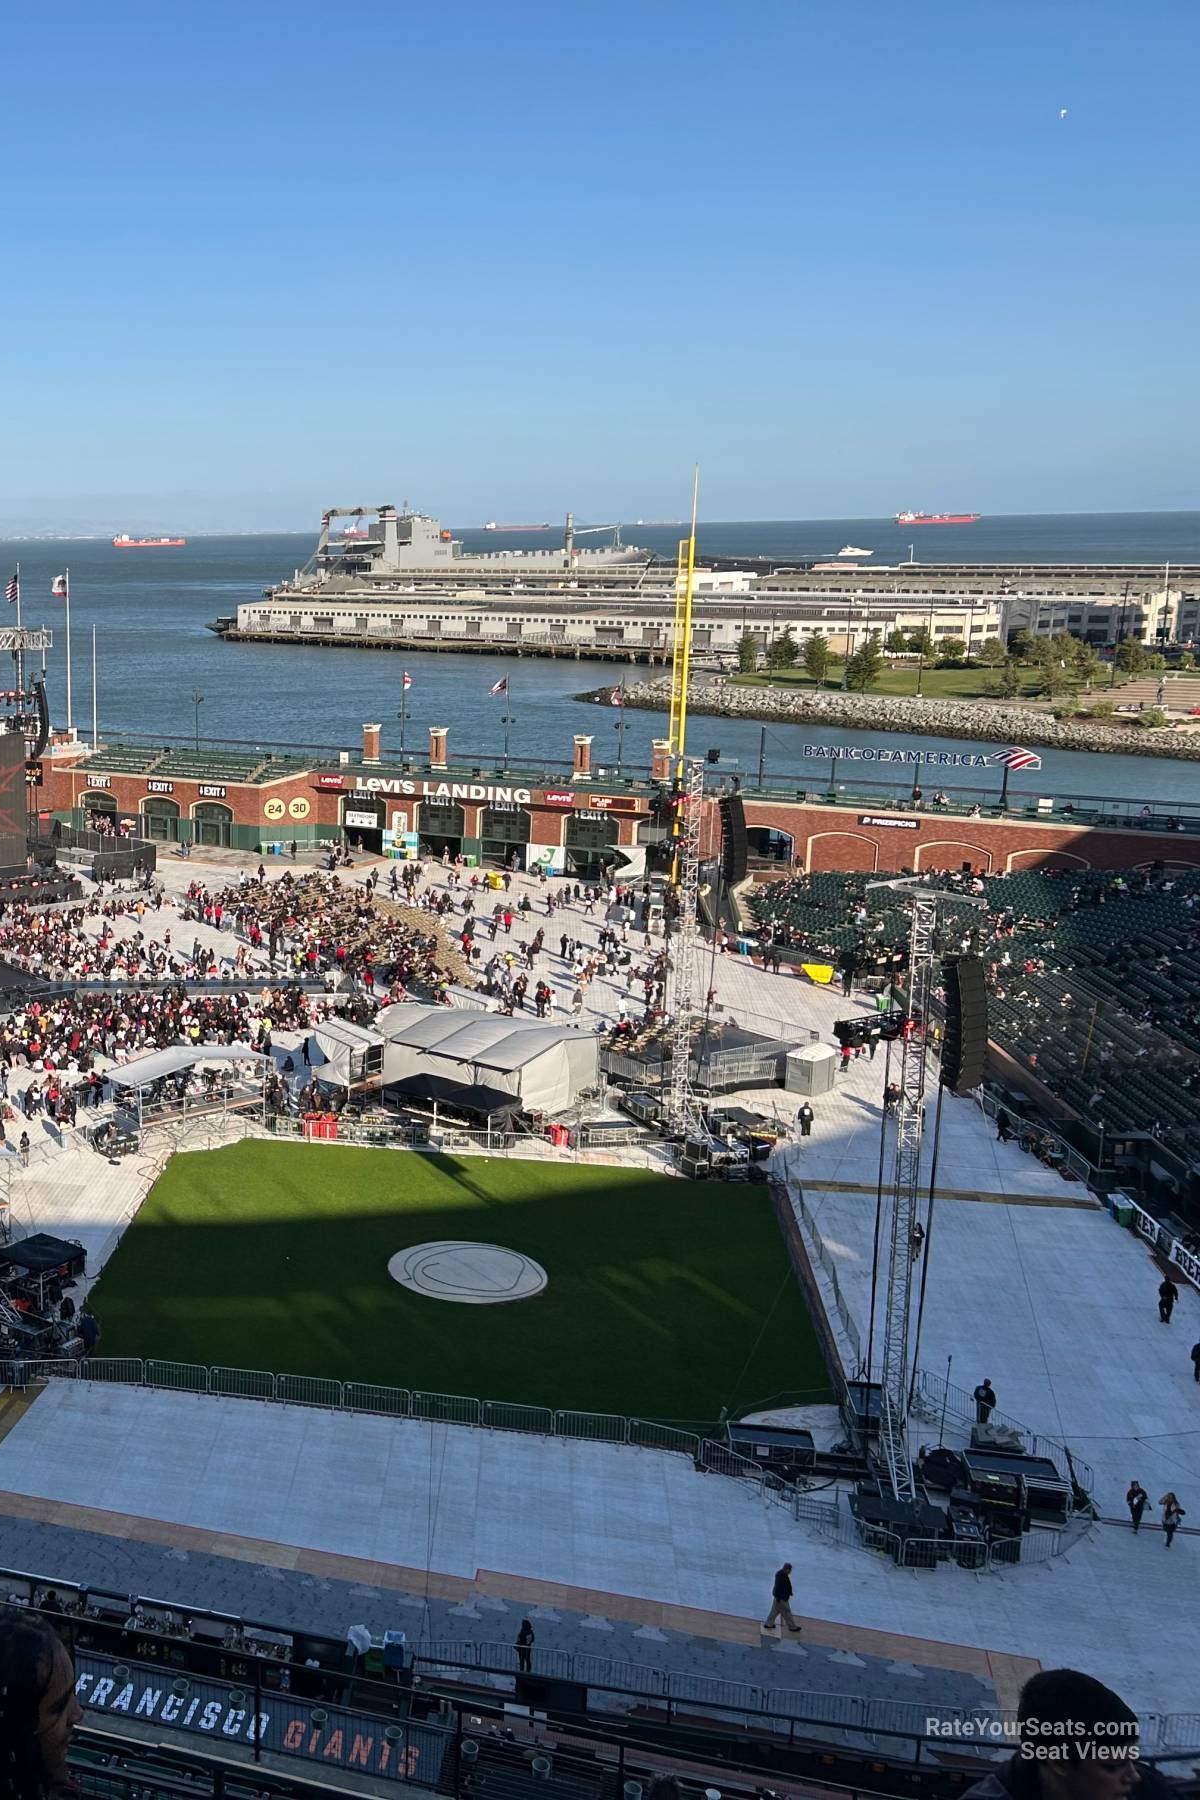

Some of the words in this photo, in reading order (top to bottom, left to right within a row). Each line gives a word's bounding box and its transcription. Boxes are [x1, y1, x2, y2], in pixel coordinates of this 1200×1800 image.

[804, 745, 855, 760] BANK
[862, 748, 885, 761] OF
[891, 751, 987, 767] AMERICA
[91, 778, 107, 787] EXIT
[152, 782, 169, 792] EXIT
[204, 785, 222, 797] EXIT
[352, 790, 371, 799] EXIT
[423, 782, 531, 804] LANDING
[430, 796, 449, 806] EXIT
[495, 801, 516, 811] EXIT
[268, 804, 282, 814] 24
[293, 803, 306, 813] 30
[580, 810, 601, 820] EXIT
[872, 818, 917, 829] PRIZEPICKS
[75, 1673, 269, 1741] FRANCISCO
[283, 1720, 420, 1777] GIANTS
